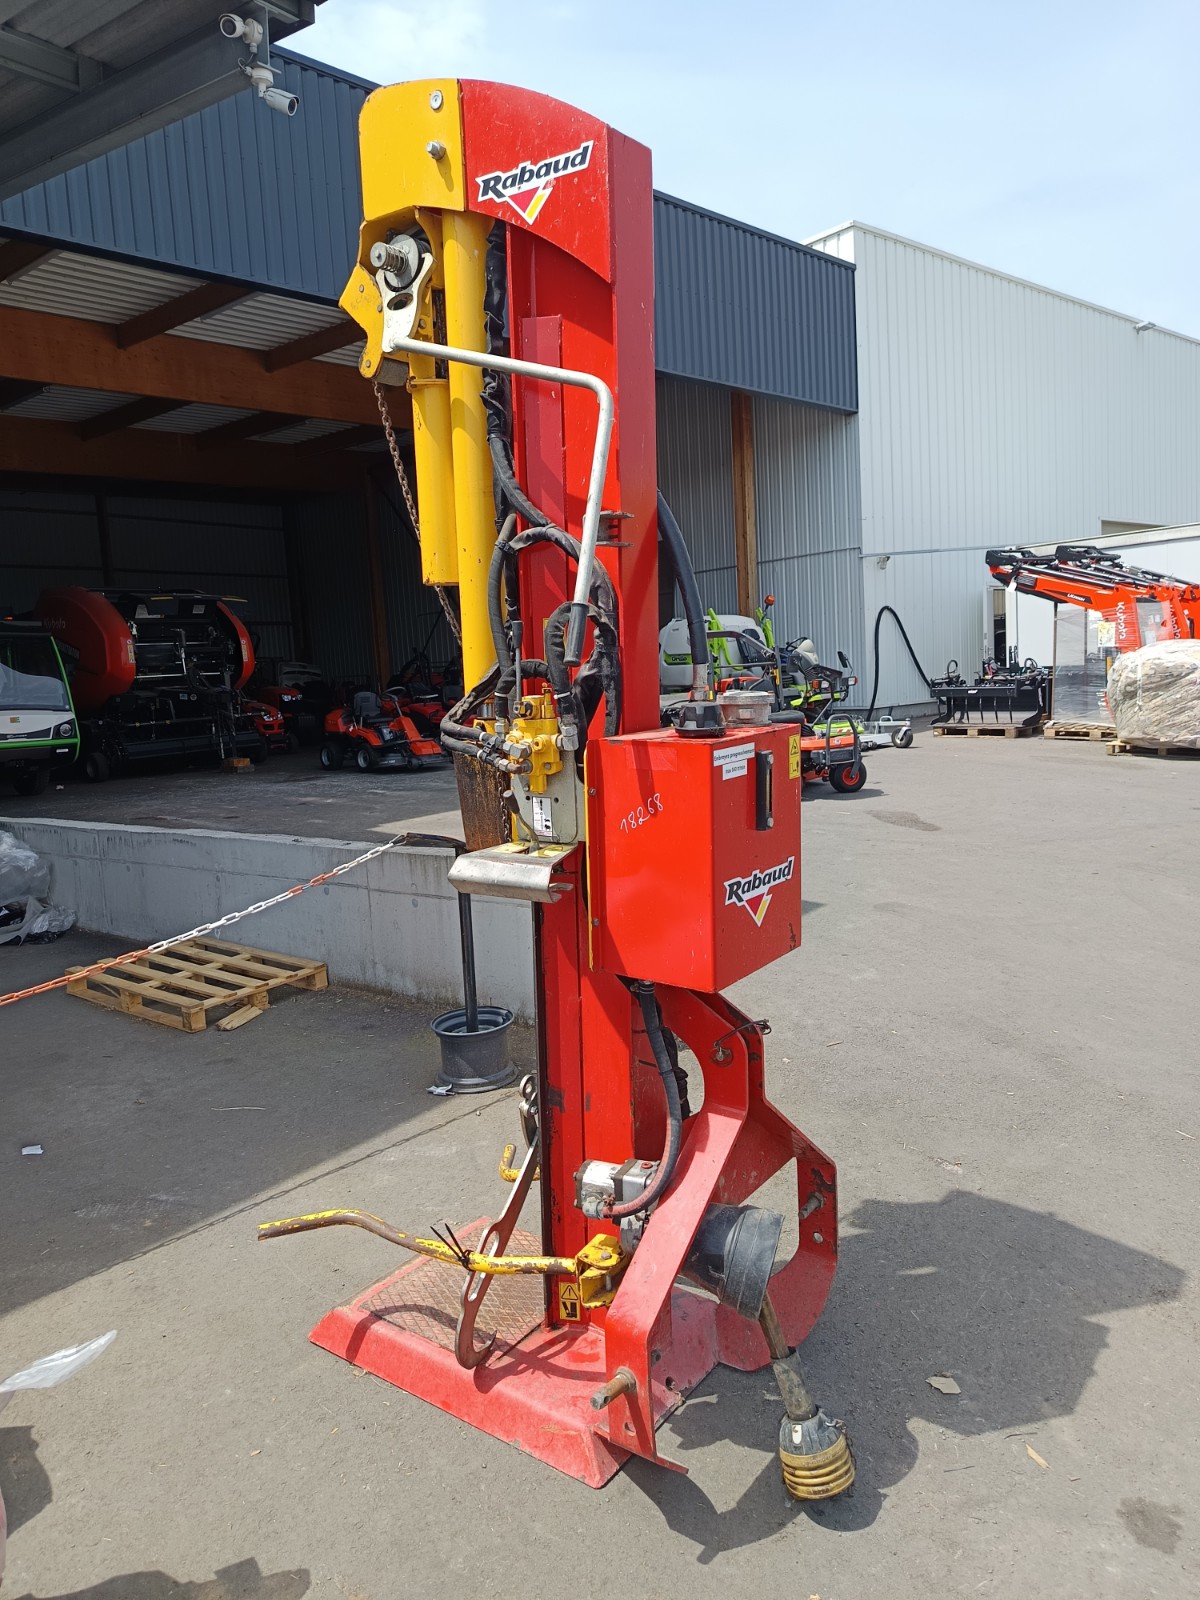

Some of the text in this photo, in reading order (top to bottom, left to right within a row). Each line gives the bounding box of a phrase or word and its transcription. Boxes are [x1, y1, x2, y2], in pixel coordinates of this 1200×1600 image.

[480, 145, 590, 199] Rabaud
[1115, 601, 1128, 639] Kubota
[620, 792, 664, 834] 18268
[727, 859, 793, 903] Rabaud
